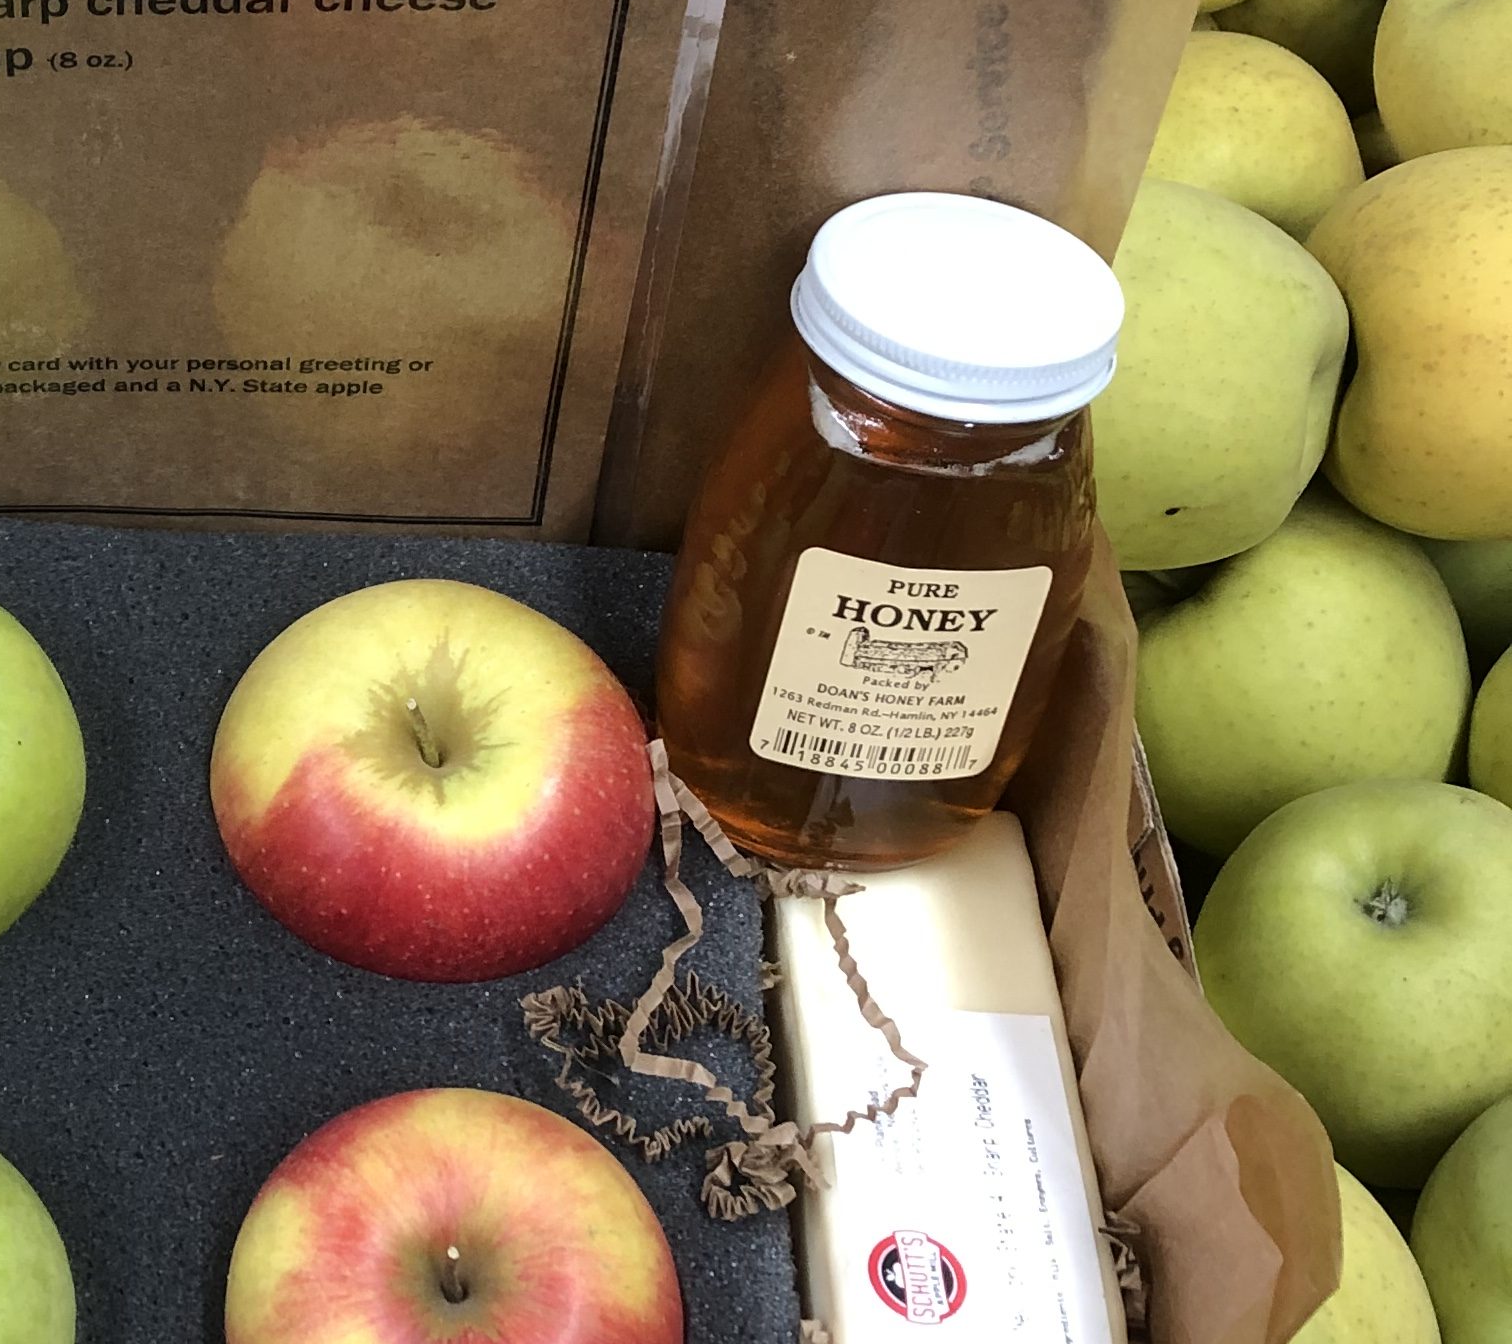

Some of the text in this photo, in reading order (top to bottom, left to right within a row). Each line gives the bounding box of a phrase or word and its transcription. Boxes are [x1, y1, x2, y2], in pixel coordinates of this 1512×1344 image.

[48, 51, 78, 72] (8
[86, 50, 134, 71] oz.)
[7, 356, 61, 373] card
[67, 355, 119, 372] with
[126, 356, 180, 374] your
[186, 356, 292, 375] personal
[299, 356, 402, 375] greeting
[408, 357, 434, 373] or
[113, 377, 158, 394] and
[165, 379, 181, 393] a
[189, 378, 236, 394] N.Y.
[242, 378, 308, 395] State
[315, 379, 383, 398] apple
[887, 579, 960, 599] PURE
[831, 594, 999, 633] HONEY
[817, 682, 966, 707] DOAN'S HONEY FARM
[862, 675, 930, 692] Packed by
[772, 686, 803, 704] 1263
[806, 696, 858, 715] Redman
[940, 711, 958, 720] NY
[962, 706, 999, 718] 14464
[786, 708, 975, 741] NET WT. 8 OZ. (1/2 LB.) 227g
[760, 739, 770, 750] 7
[967, 759, 978, 770] 7
[901, 1236, 936, 1318] SCHUTT'S
